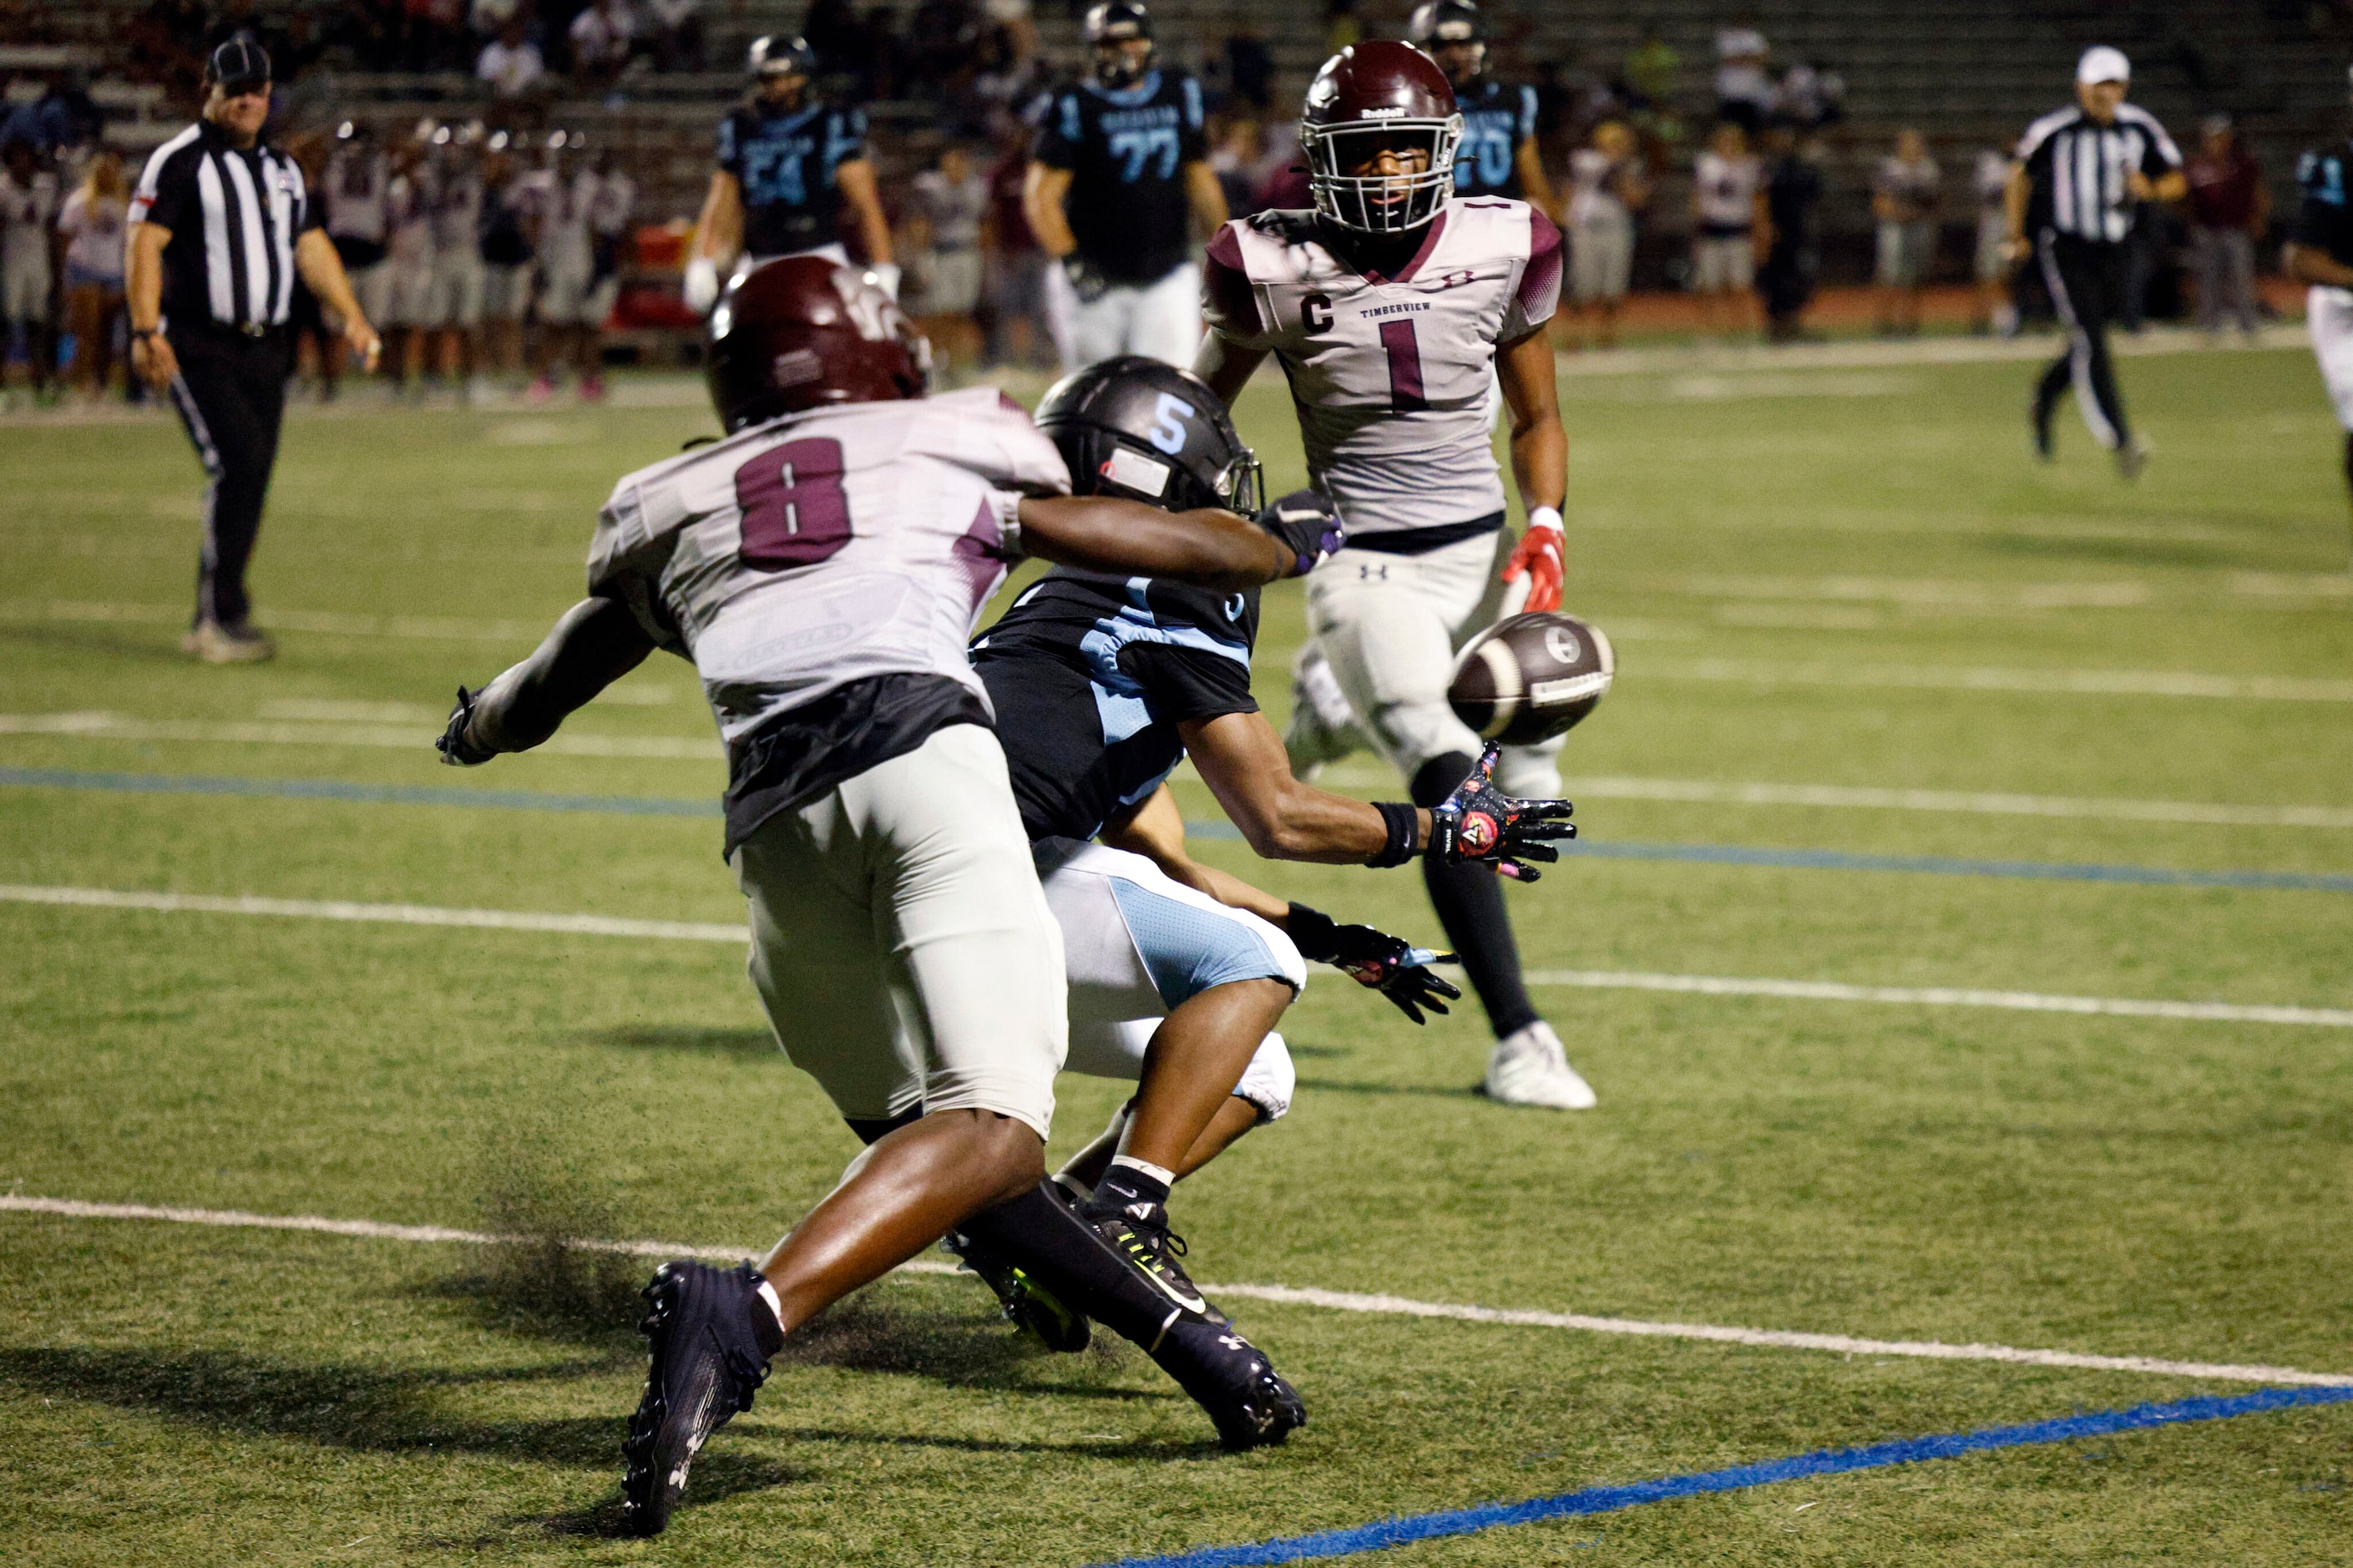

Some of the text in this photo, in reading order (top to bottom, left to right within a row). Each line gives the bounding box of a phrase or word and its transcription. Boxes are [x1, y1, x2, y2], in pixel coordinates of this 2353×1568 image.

[1361, 107, 1405, 119] Riddell
[1109, 129, 1180, 183] 77
[1300, 294, 1334, 333] C
[1360, 302, 1430, 319] TIMBERVIEW
[1379, 319, 1430, 412] 1
[735, 438, 853, 574] 8
